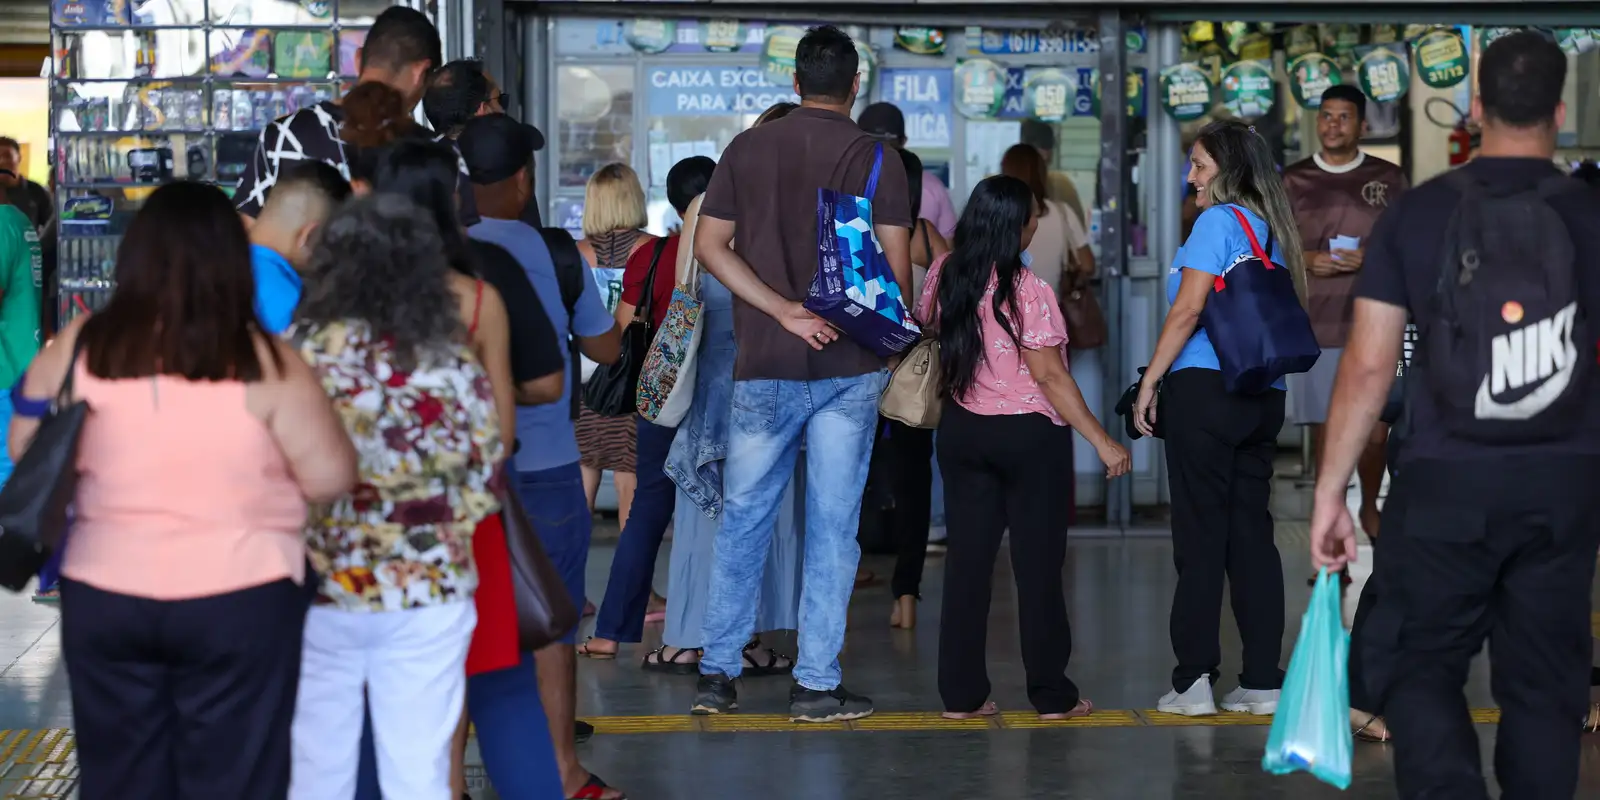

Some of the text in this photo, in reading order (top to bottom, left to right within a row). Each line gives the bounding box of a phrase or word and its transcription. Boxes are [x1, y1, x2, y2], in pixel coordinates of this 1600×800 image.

[652, 70, 775, 87] CAIXA EXCL
[1428, 65, 1464, 82] 31/12
[894, 75, 940, 101] FILA
[677, 94, 728, 110] PARA
[904, 112, 949, 139] NICA
